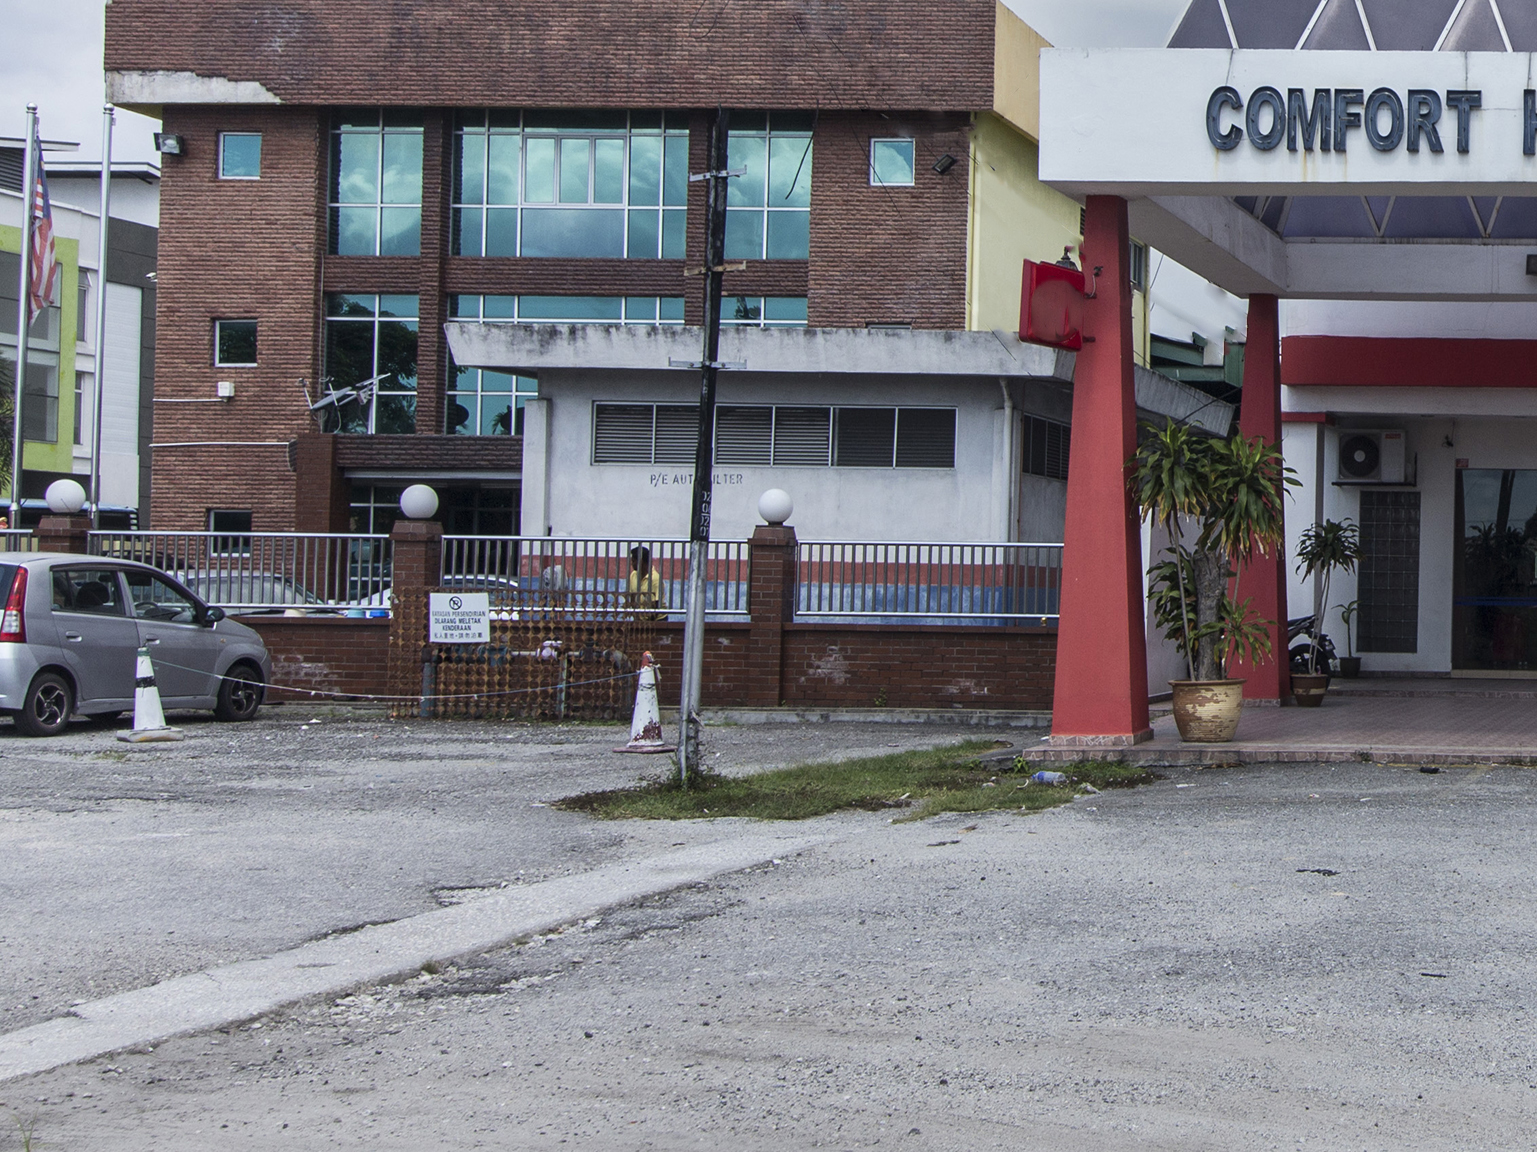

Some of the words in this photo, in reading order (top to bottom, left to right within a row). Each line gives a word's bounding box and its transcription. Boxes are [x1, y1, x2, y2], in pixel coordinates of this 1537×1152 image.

[1205, 85, 1483, 154] COMFORT
[650, 472, 669, 488] P/E
[672, 474, 694, 485] AUT
[712, 474, 743, 485] ILTER
